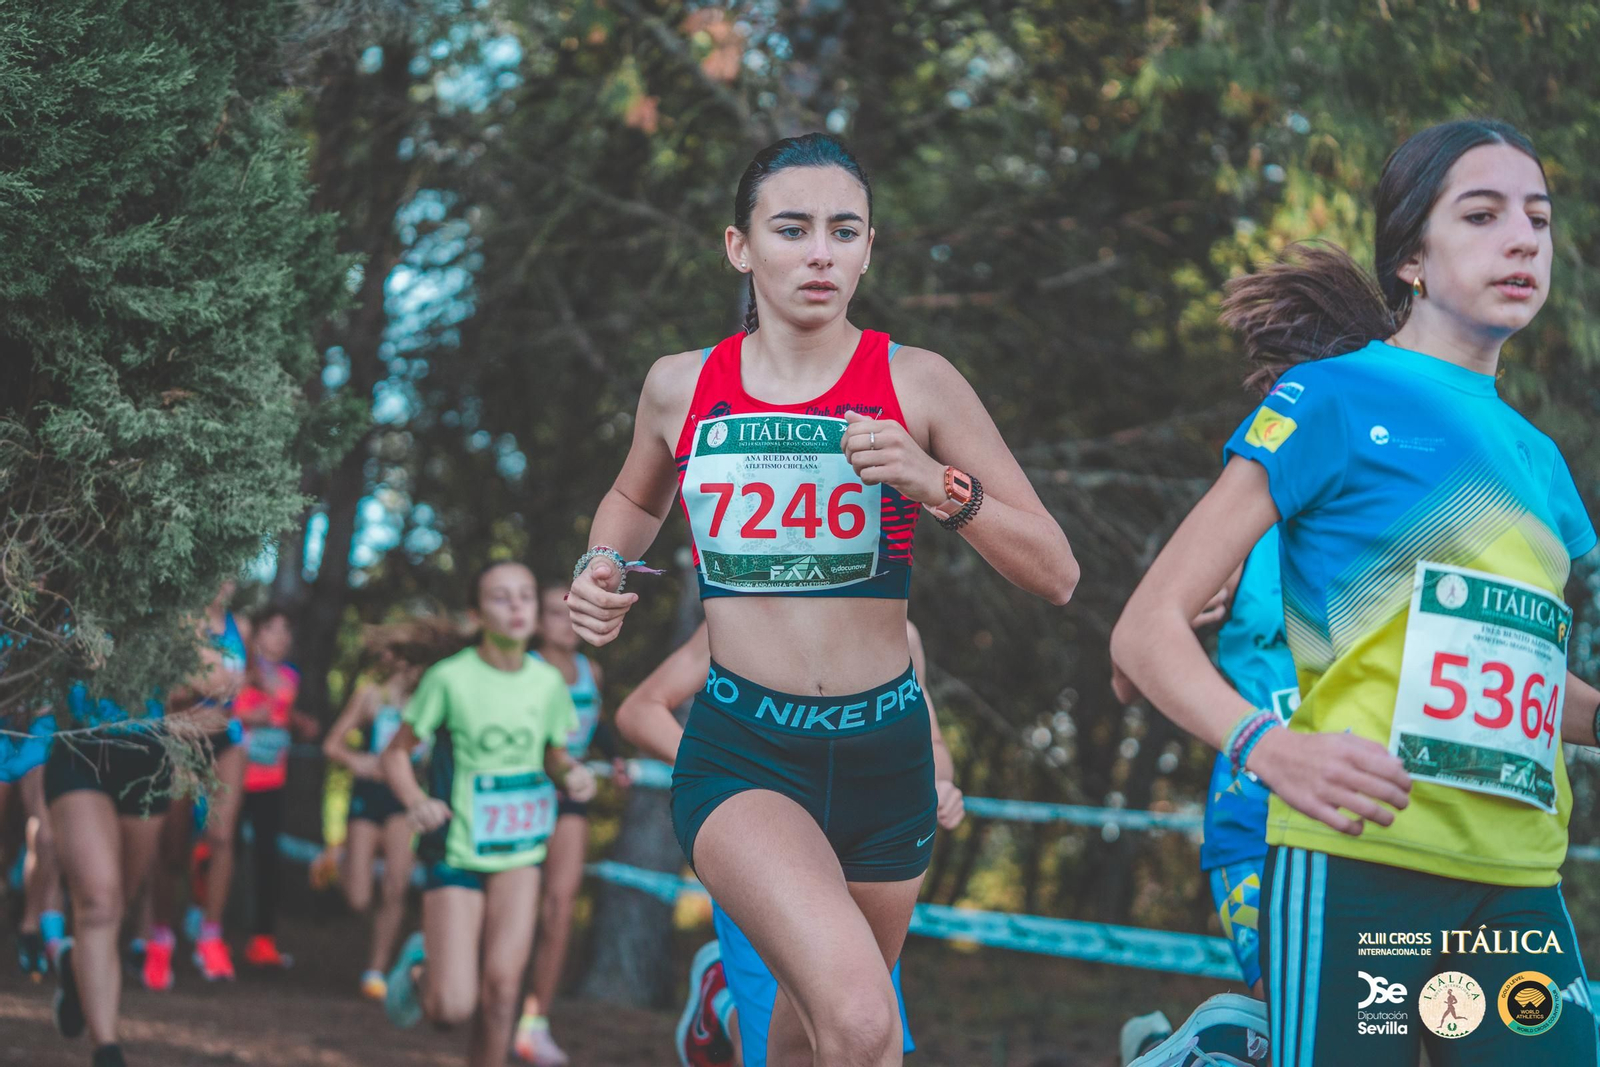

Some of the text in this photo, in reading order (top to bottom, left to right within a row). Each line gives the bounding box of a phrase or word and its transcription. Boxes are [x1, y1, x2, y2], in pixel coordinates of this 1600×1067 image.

[805, 406, 830, 416] Club
[739, 418, 827, 441] ITÁLICA
[745, 454, 818, 462] ANA RUEDA OLMO
[700, 482, 866, 539] 7246
[1482, 586, 1556, 630] ITÁLICA
[755, 696, 868, 730] NIKE
[1423, 651, 1559, 749] 5364
